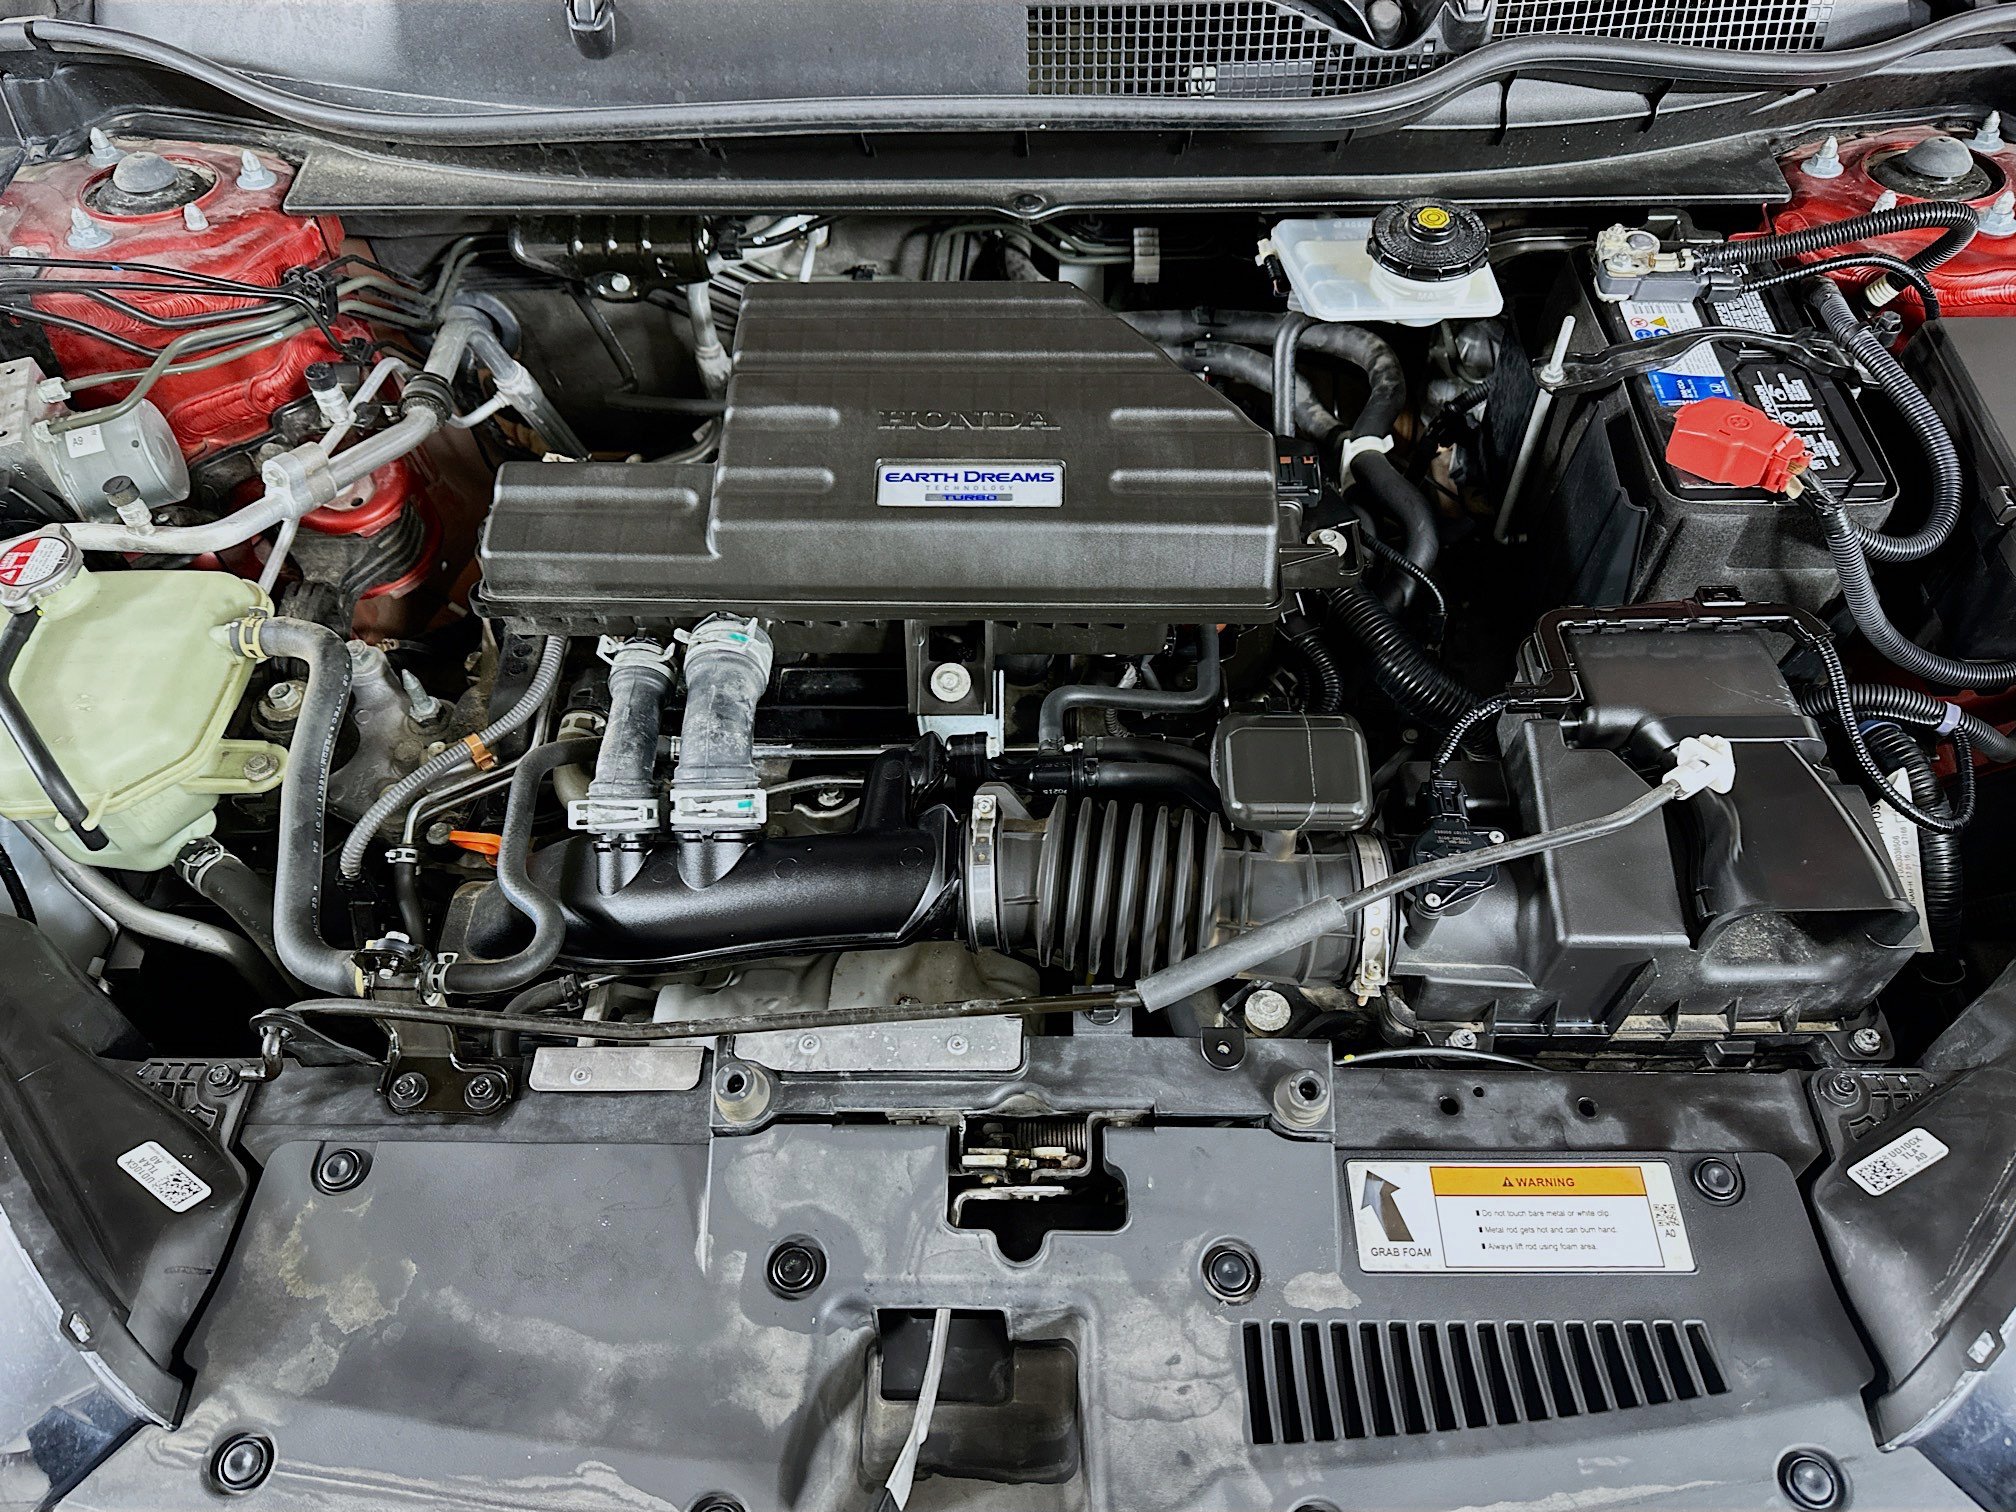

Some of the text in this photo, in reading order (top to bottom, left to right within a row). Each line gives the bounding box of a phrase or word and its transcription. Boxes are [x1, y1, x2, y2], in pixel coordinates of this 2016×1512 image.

[877, 409, 1062, 431] HONDA
[885, 470, 1055, 483] EARTH DREAMS
[941, 493, 998, 501] TURBO
[1888, 1135, 1923, 1159] UD10GX
[125, 1158, 156, 1184] UD10GX
[138, 1157, 159, 1174] TLAA
[1516, 1177, 1575, 1188] WARNING
[1520, 1226, 1535, 1235] gets
[1370, 1247, 1432, 1257] GRAB FOAM
[1488, 1243, 1513, 1251] Always
[1539, 1243, 1558, 1251] using
